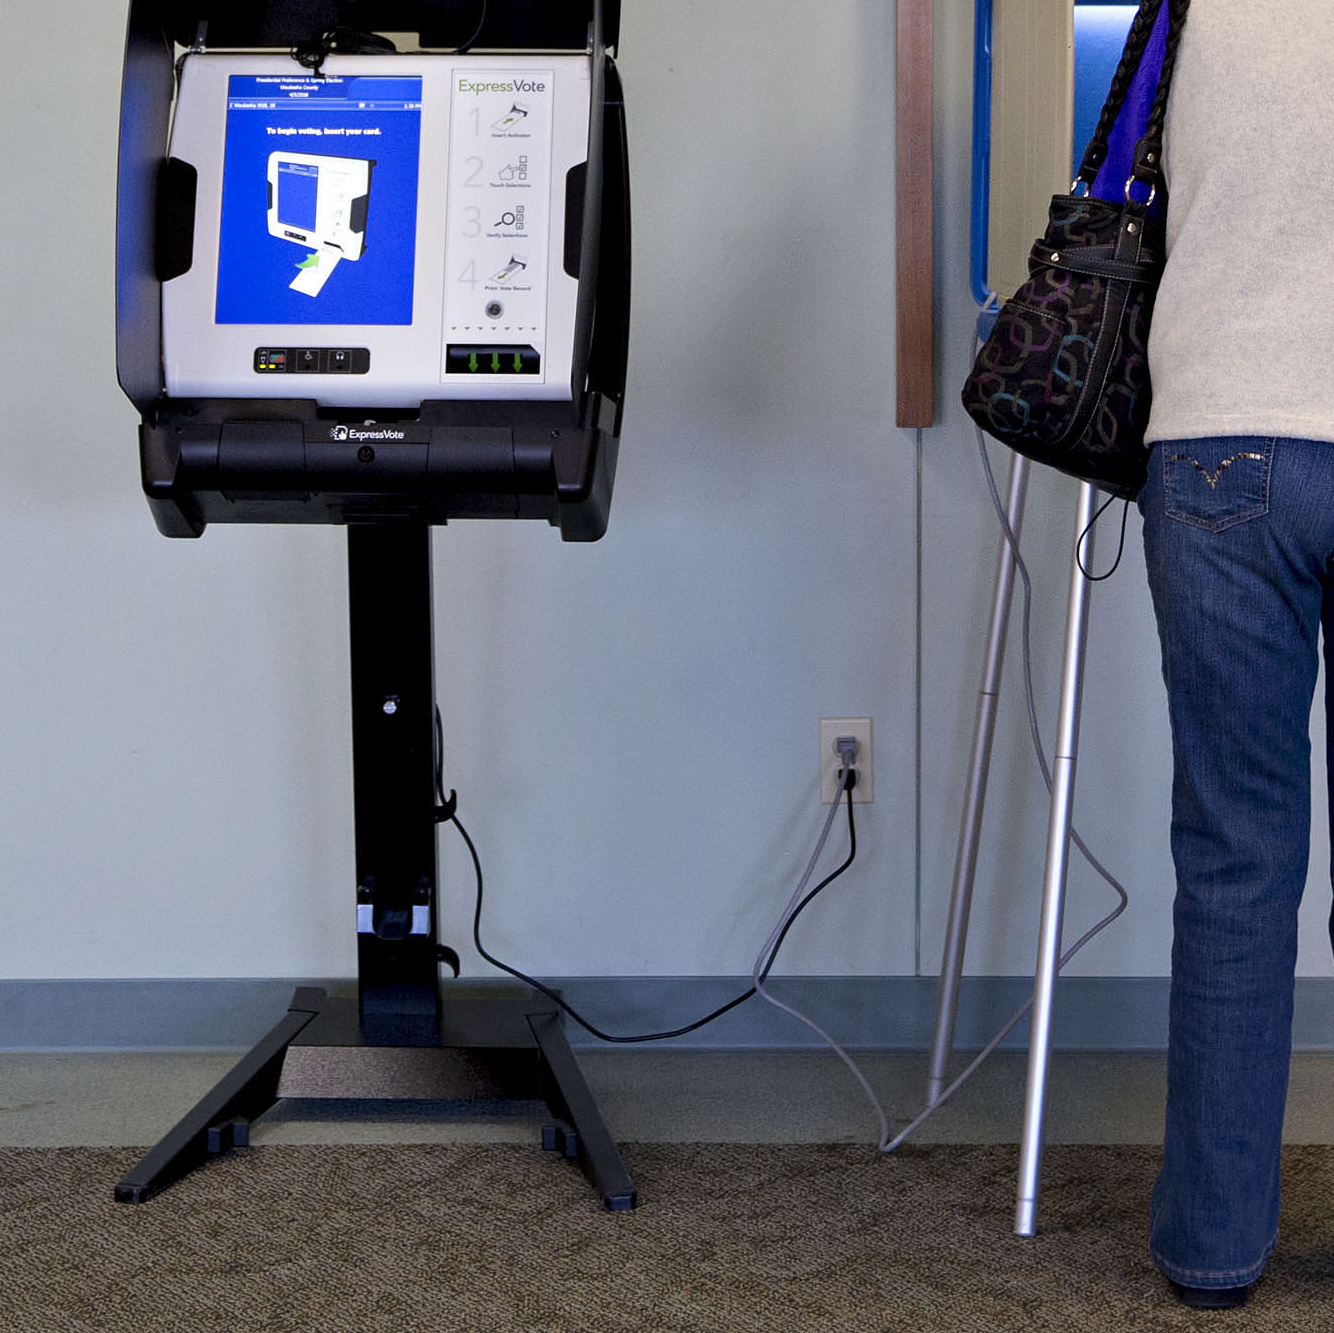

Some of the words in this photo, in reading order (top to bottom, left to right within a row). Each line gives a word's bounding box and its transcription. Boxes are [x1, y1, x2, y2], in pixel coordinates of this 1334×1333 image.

[458, 79, 546, 96] ExpressVote
[266, 127, 276, 135] To
[277, 127, 297, 136] begin
[298, 127, 322, 136] voting,
[345, 128, 362, 136] your
[363, 127, 381, 135] card.
[469, 107, 479, 137] 1
[463, 156, 483, 187] 2
[462, 206, 481, 237] 3
[458, 259, 480, 290] 4
[349, 430, 404, 441] ExpressVote
